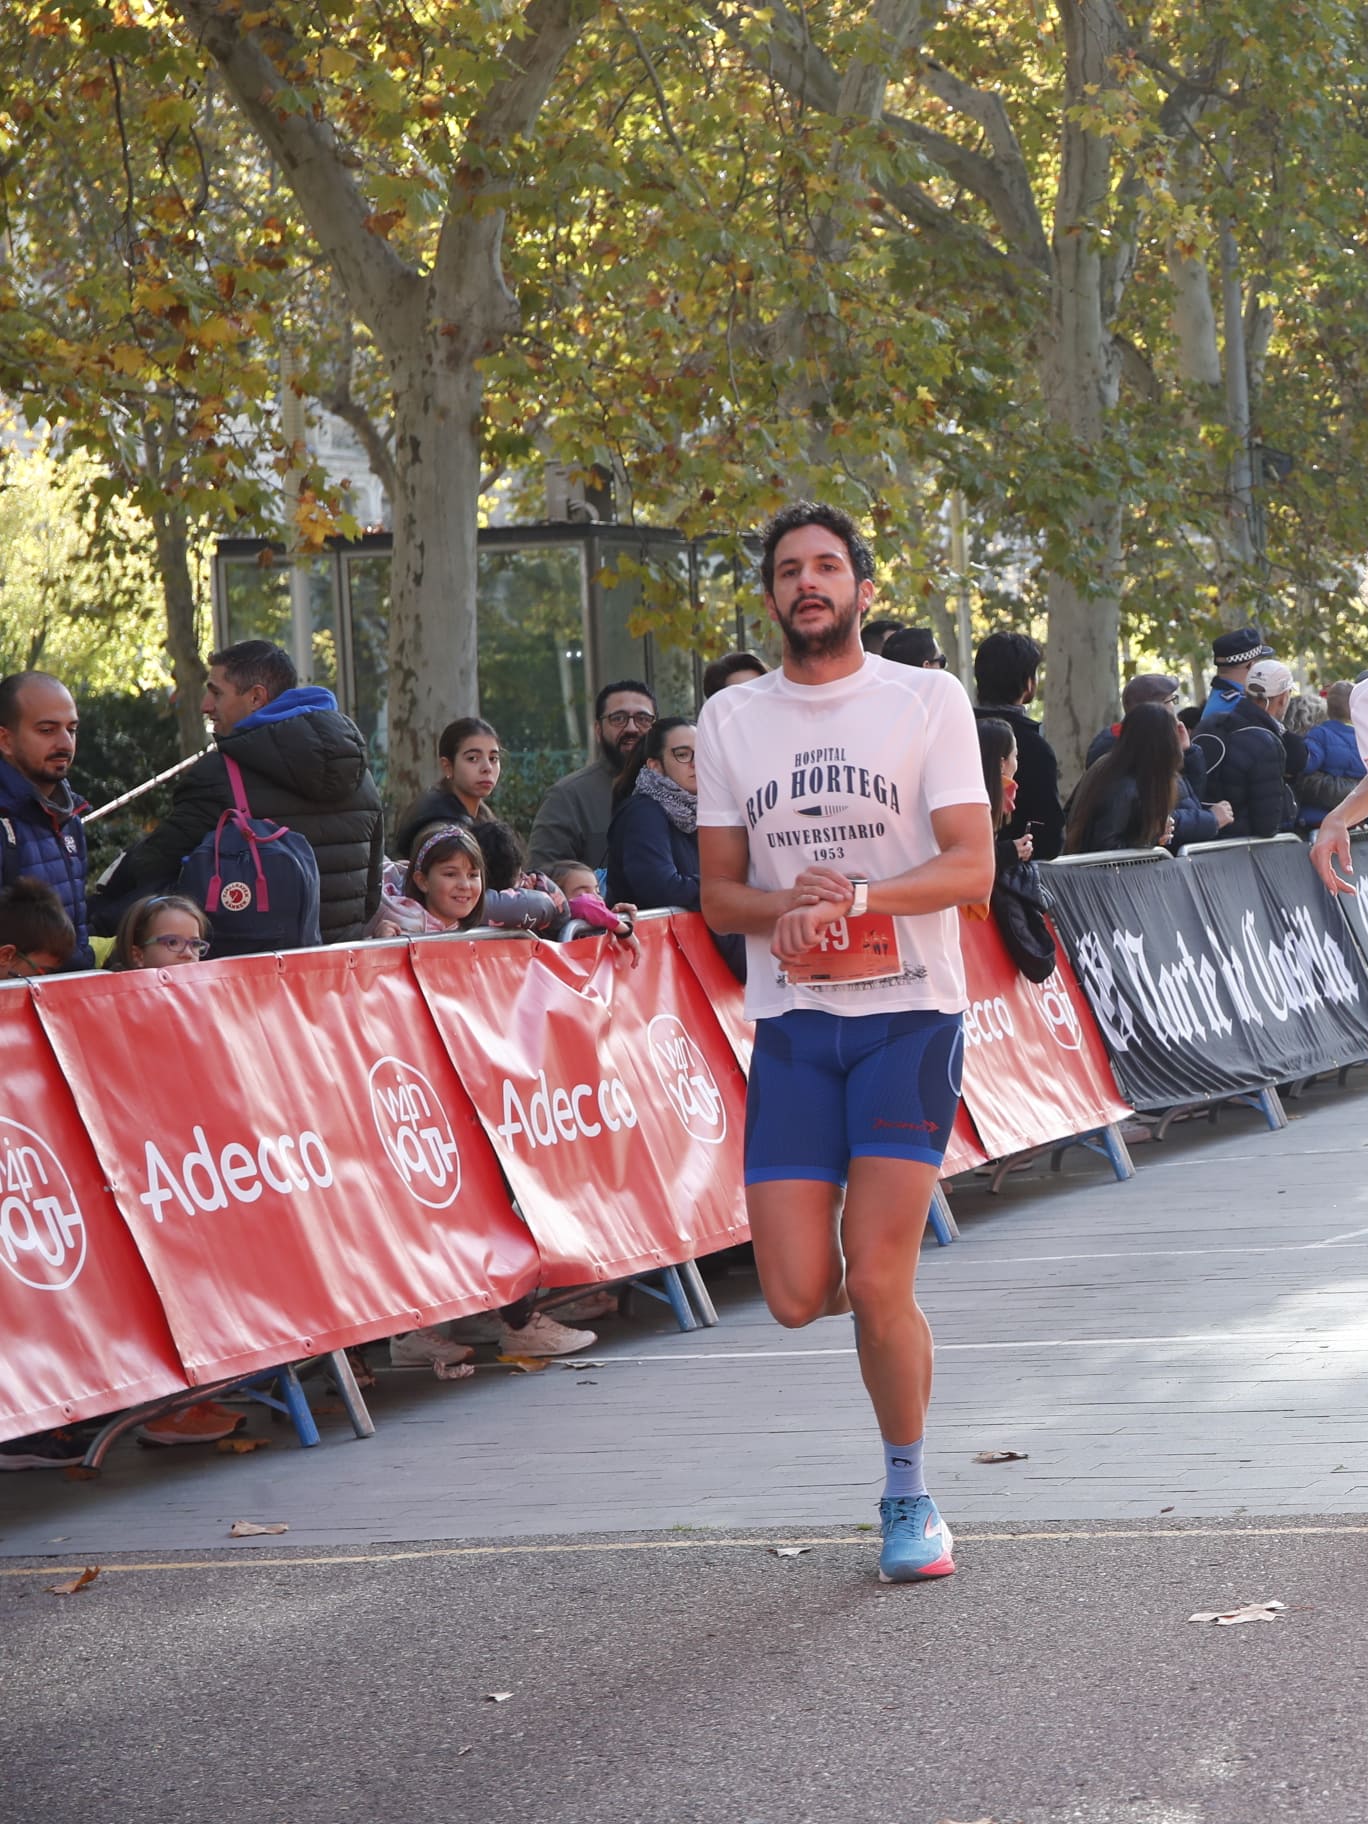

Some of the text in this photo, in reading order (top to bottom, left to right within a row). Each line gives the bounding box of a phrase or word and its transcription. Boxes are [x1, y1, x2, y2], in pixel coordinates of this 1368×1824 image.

[794, 747, 847, 767] HOSPITAL
[746, 765, 901, 831] RIO HORTEGA
[766, 822, 885, 848] UNIVERSITARIO
[813, 847, 845, 862] 1953
[1077, 930, 1142, 1052] El
[963, 997, 1015, 1049] ecco
[497, 1068, 638, 1153] Adecco
[139, 1125, 334, 1223] Adecco
